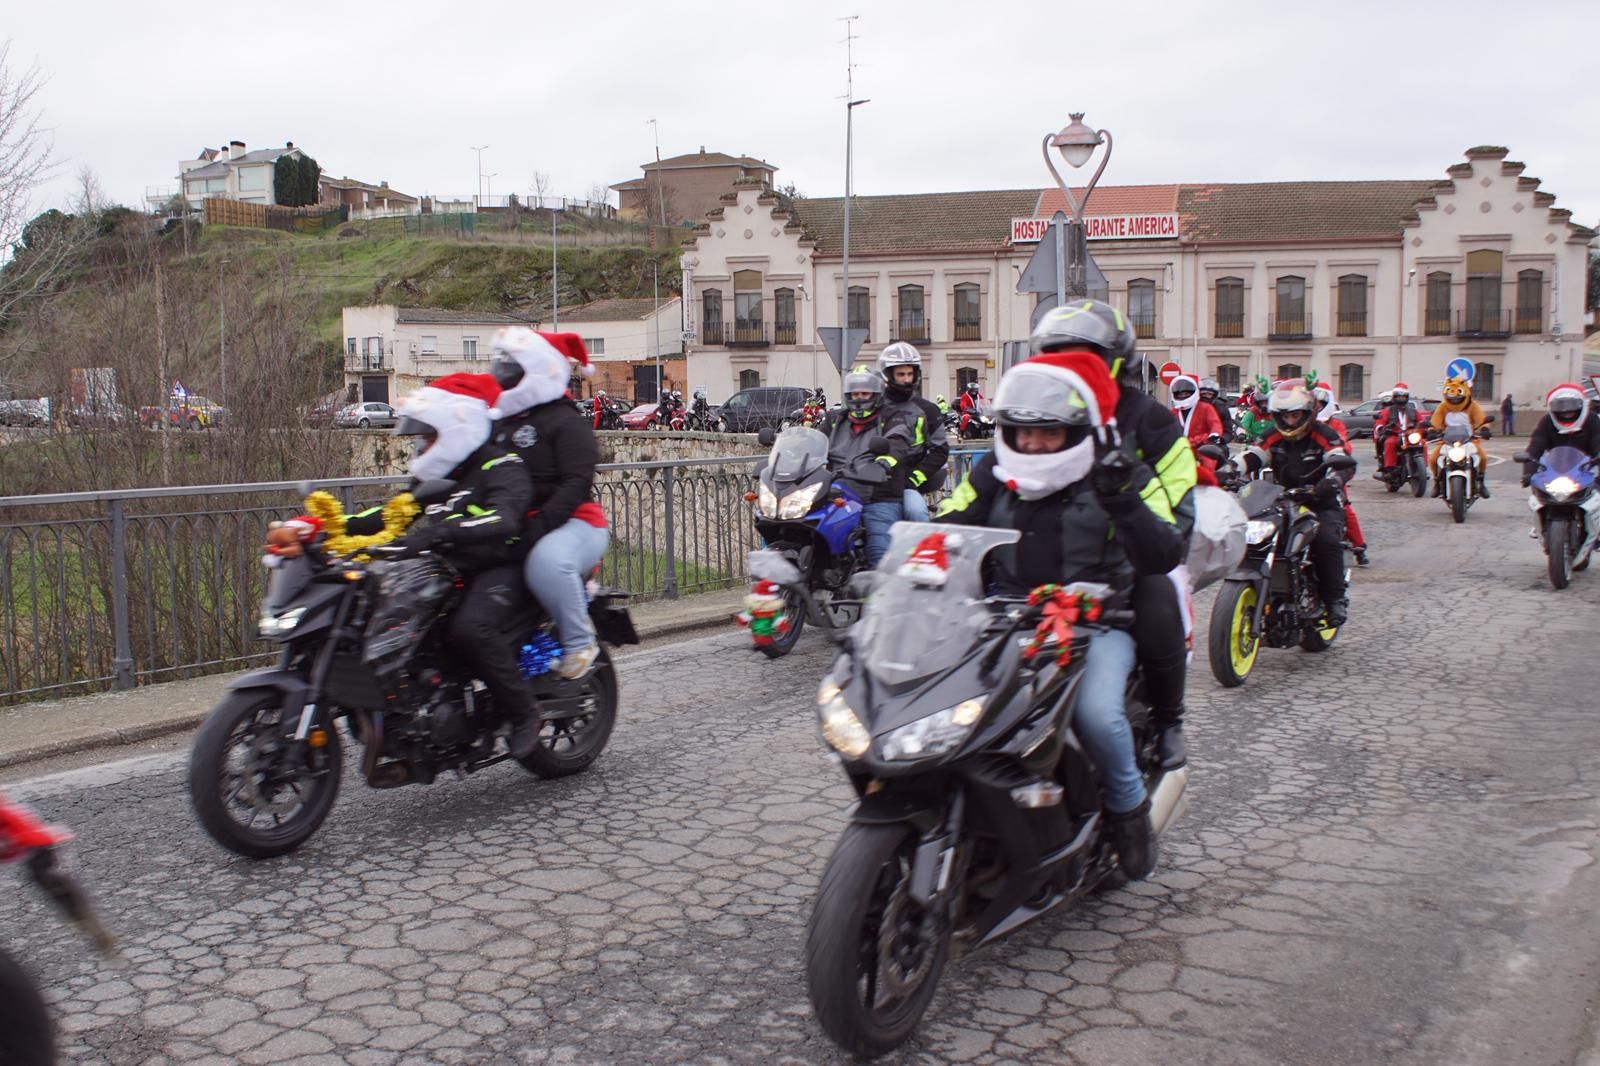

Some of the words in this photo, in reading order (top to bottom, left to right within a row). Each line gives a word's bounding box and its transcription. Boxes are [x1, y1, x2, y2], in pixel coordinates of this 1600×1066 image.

[1014, 220, 1050, 239] HOSTA
[1069, 217, 1125, 238] URANTE
[1128, 216, 1174, 235] AMERICA
